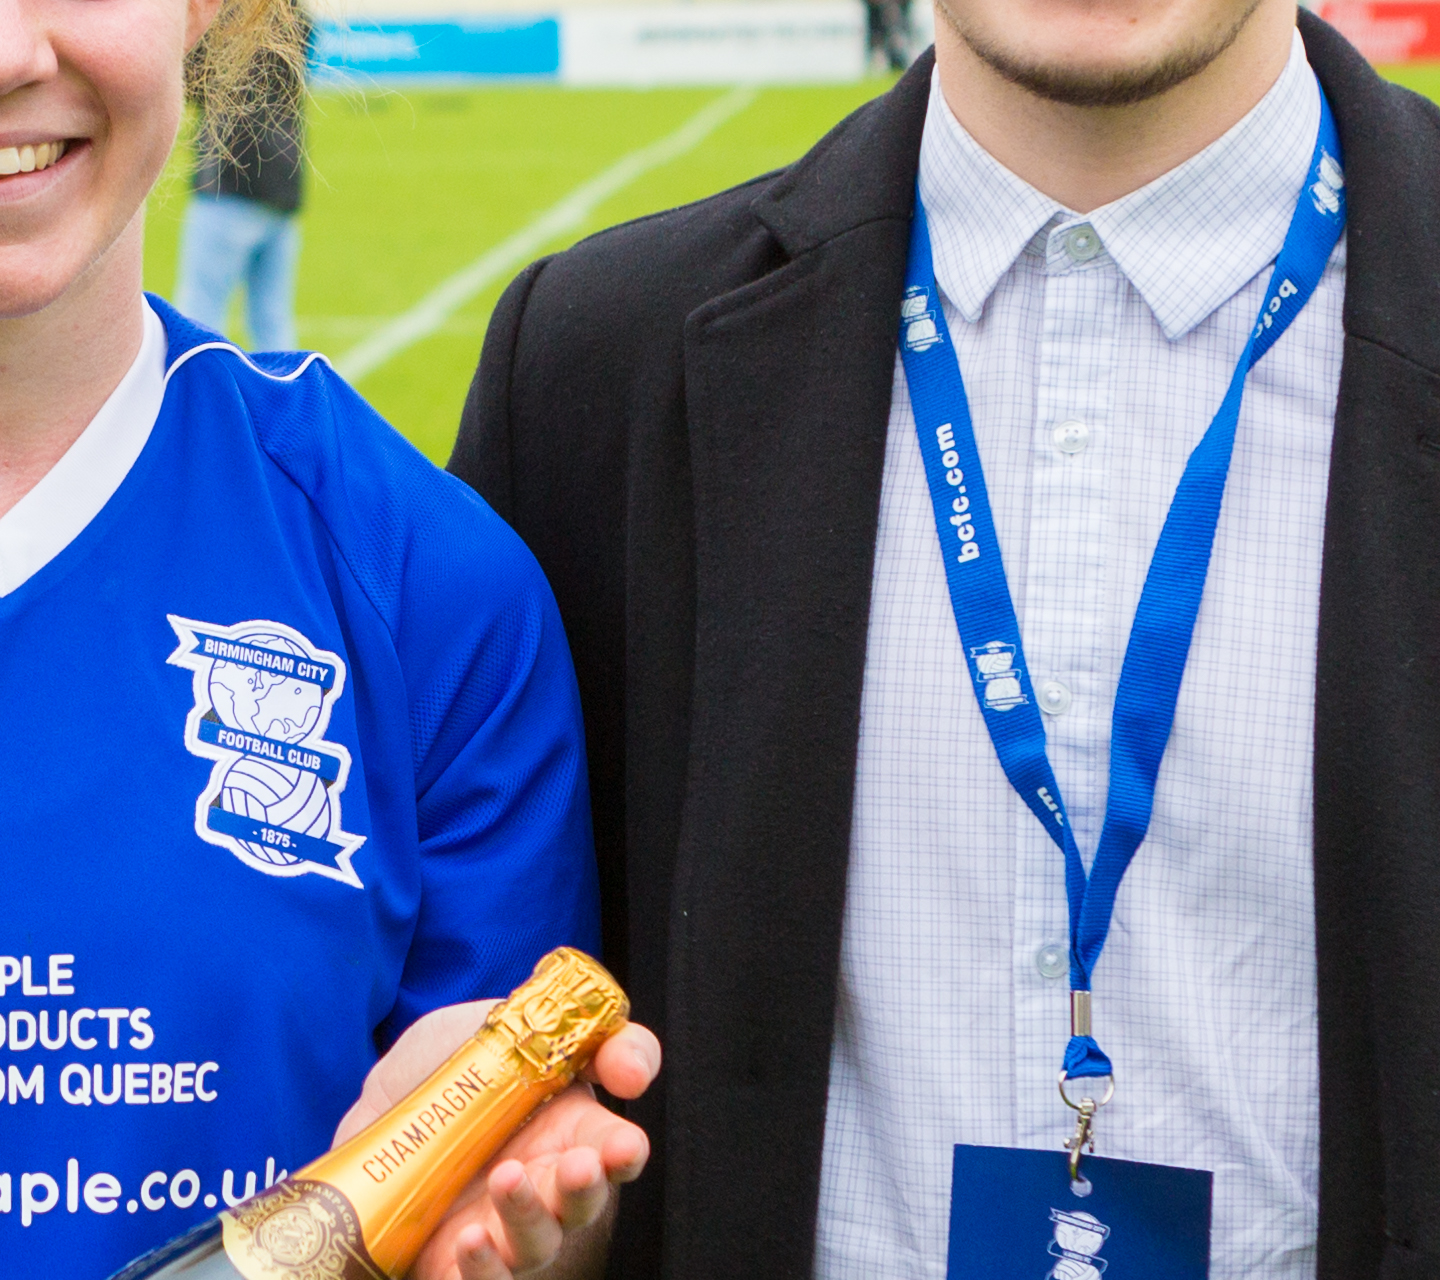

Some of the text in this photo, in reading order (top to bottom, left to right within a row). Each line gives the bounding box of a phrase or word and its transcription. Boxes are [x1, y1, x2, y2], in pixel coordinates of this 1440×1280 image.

[936, 423, 980, 563] bcfc.com
[204, 638, 328, 682] BIRMINGHAM CITY
[218, 730, 321, 770] FOOTBALL CLUB
[60, 1061, 219, 1106] QUEBEC
[362, 1062, 495, 1183] CHAMPAGNE
[293, 1182, 357, 1244] CHAMPAGNE
